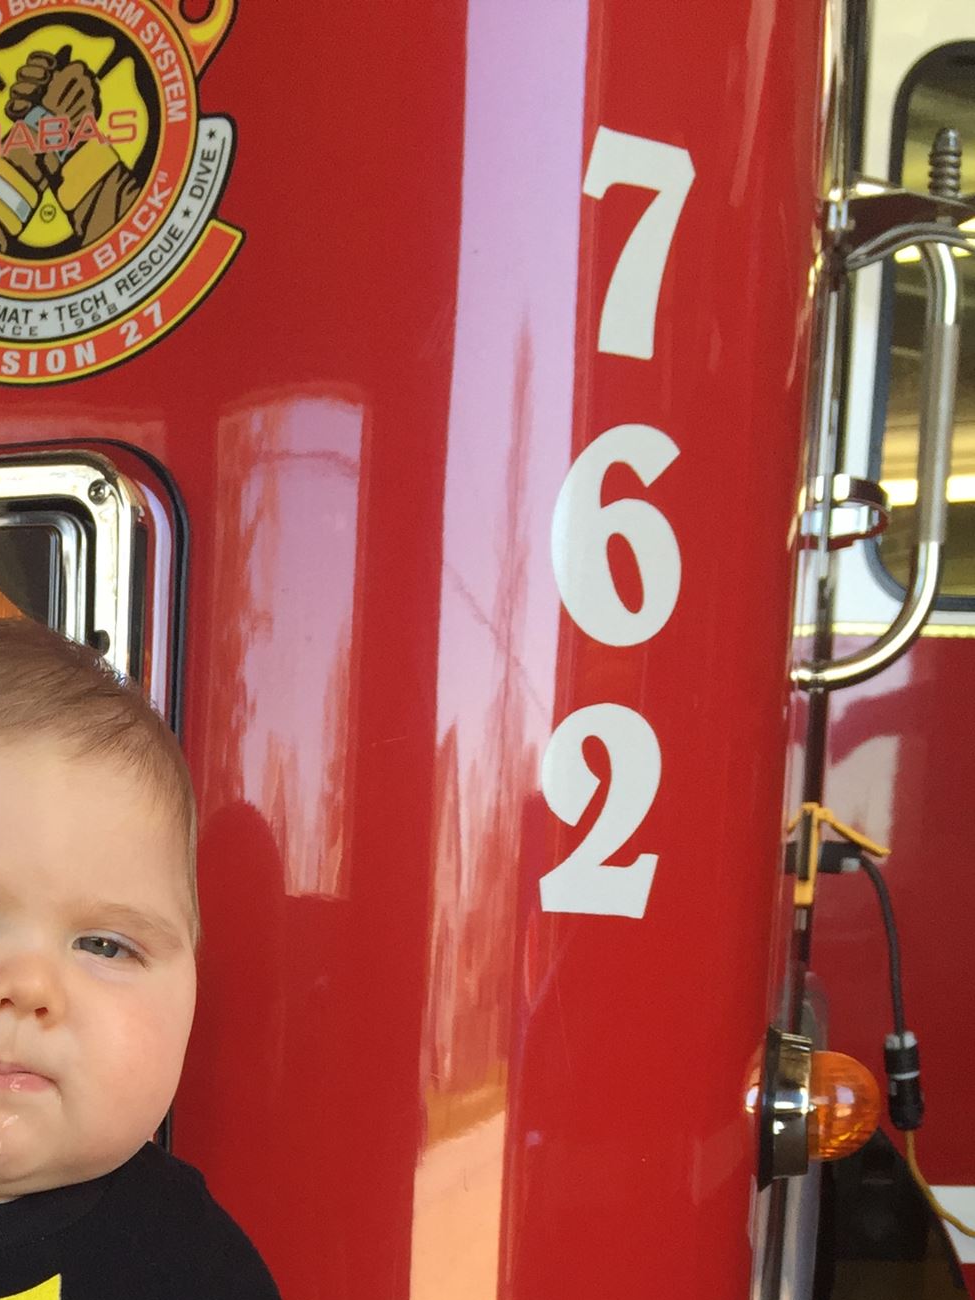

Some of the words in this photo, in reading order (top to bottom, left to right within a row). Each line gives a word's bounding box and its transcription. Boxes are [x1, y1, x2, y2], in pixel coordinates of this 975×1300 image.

[63, 0, 144, 29] ARM
[139, 21, 187, 123] SYSTEM
[54, 289, 108, 322] TECH
[115, 223, 184, 297] RESCUE
[189, 147, 217, 201] DIVE
[60, 303, 119, 333] 1968
[119, 300, 165, 348] 27
